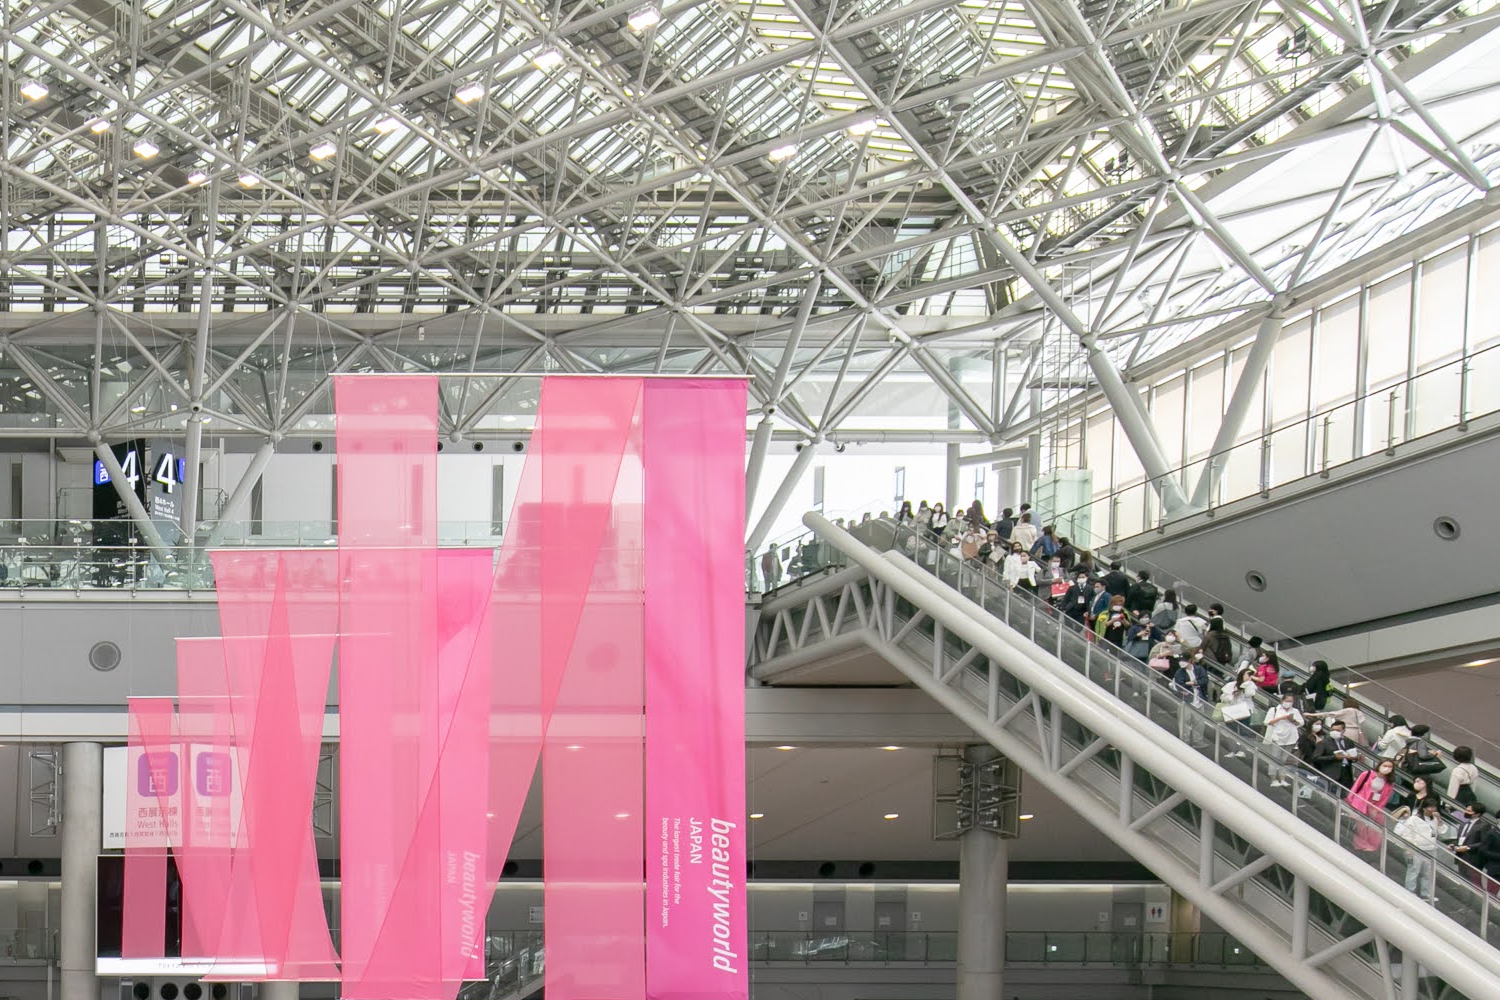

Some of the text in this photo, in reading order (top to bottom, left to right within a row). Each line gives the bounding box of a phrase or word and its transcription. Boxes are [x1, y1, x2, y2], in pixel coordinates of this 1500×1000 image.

[121, 451, 139, 490] 4
[157, 453, 176, 493] 4
[138, 821, 156, 829] West
[661, 818, 669, 839] beauty
[690, 817, 702, 864] JAPAN
[661, 841, 669, 853] and
[661, 855, 669, 866] spa
[673, 818, 681, 904] The largest trade fair for the
[661, 868, 669, 898] industries
[707, 818, 737, 973] beautyworld
[459, 851, 480, 959] beautyworld
